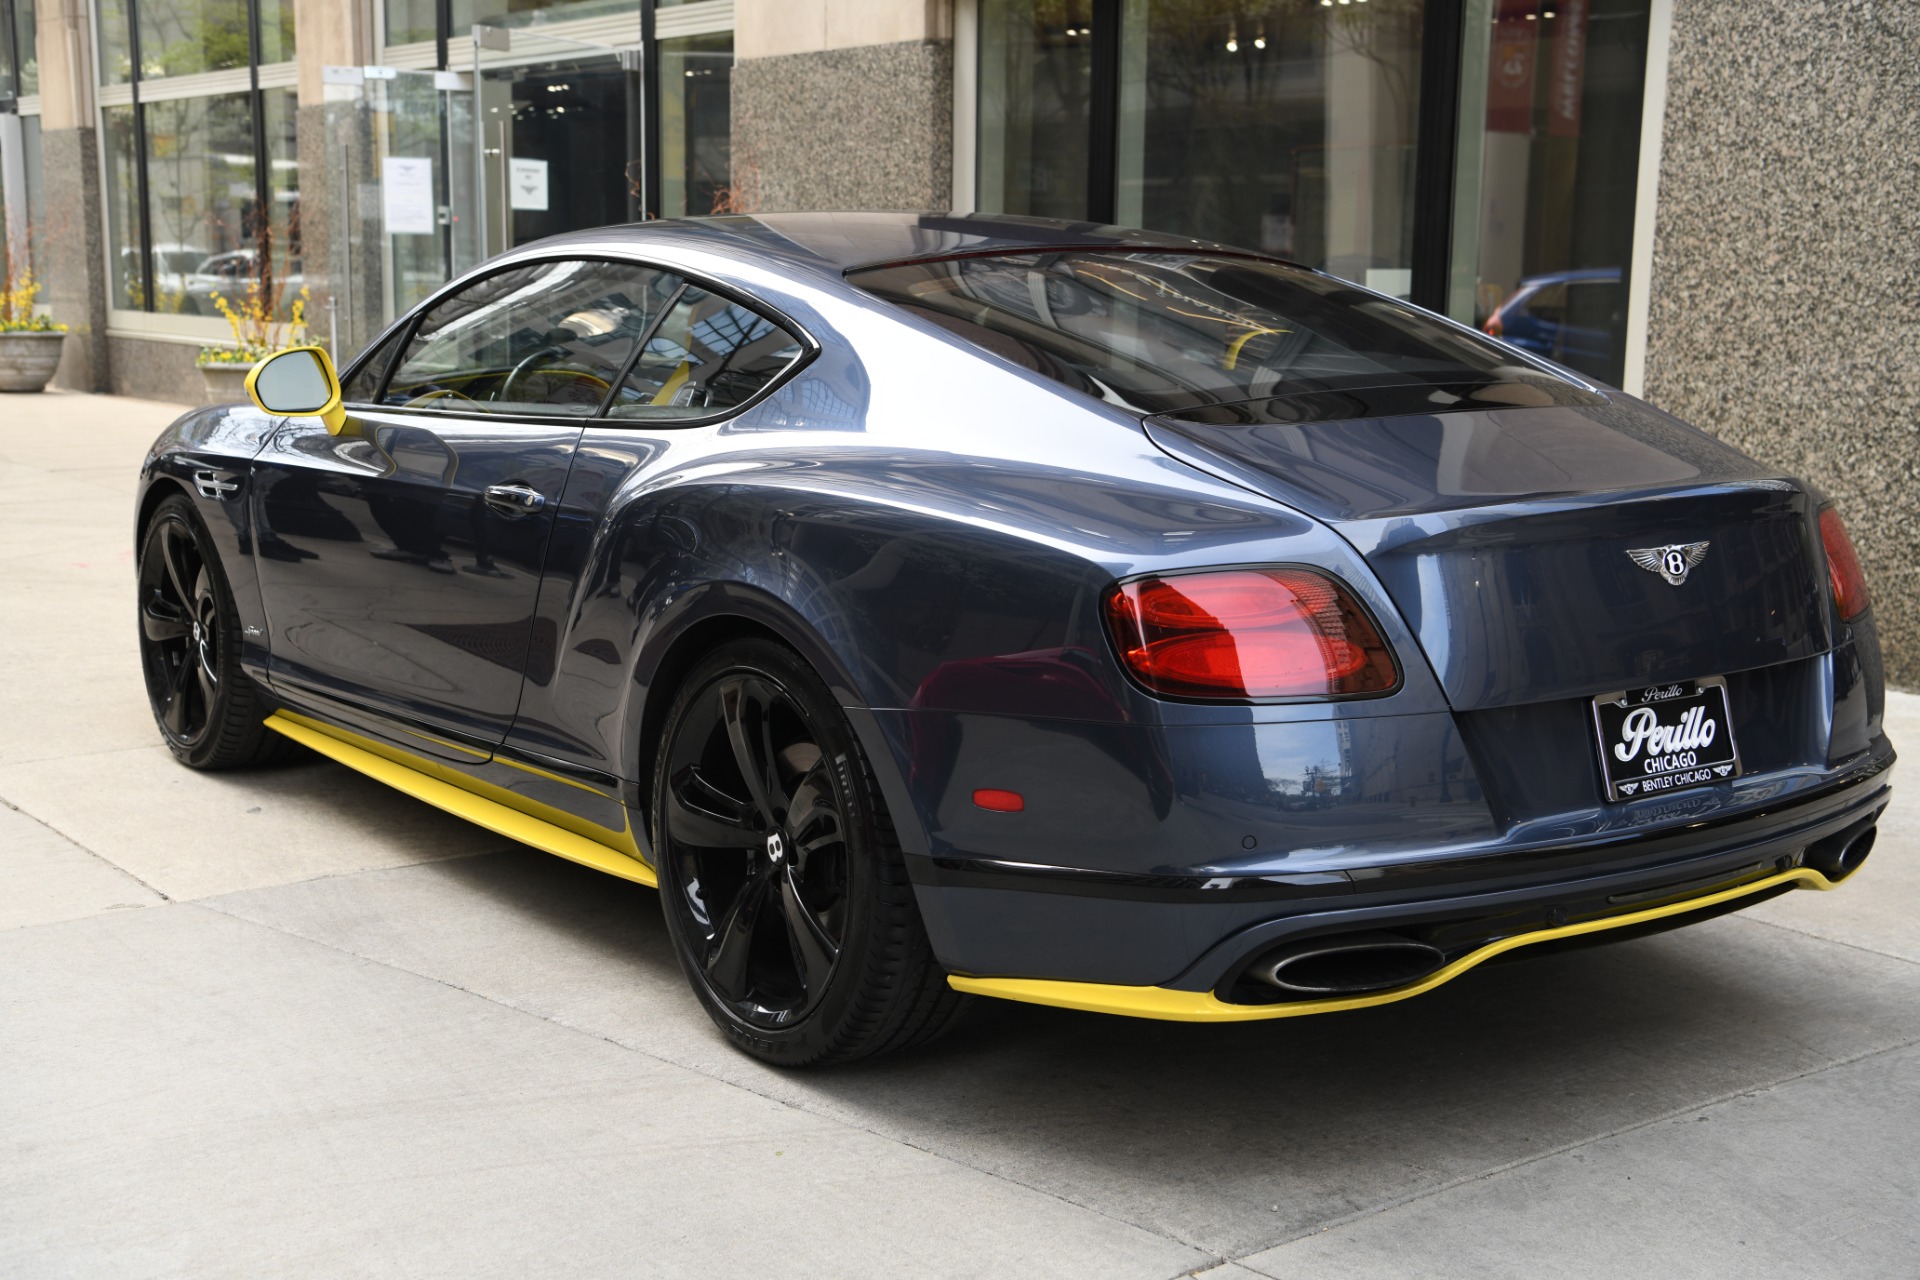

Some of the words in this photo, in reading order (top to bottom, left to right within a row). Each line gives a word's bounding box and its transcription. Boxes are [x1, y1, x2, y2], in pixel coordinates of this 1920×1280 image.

[1667, 552, 1684, 574] B
[1641, 685, 1683, 702] Perillo
[1615, 706, 1716, 762] Perillo
[1644, 751, 1697, 773] CHICAGO
[1642, 775, 1675, 792] BENTLEY
[1674, 769, 1712, 786] CHICAGO
[767, 832, 783, 863] B
